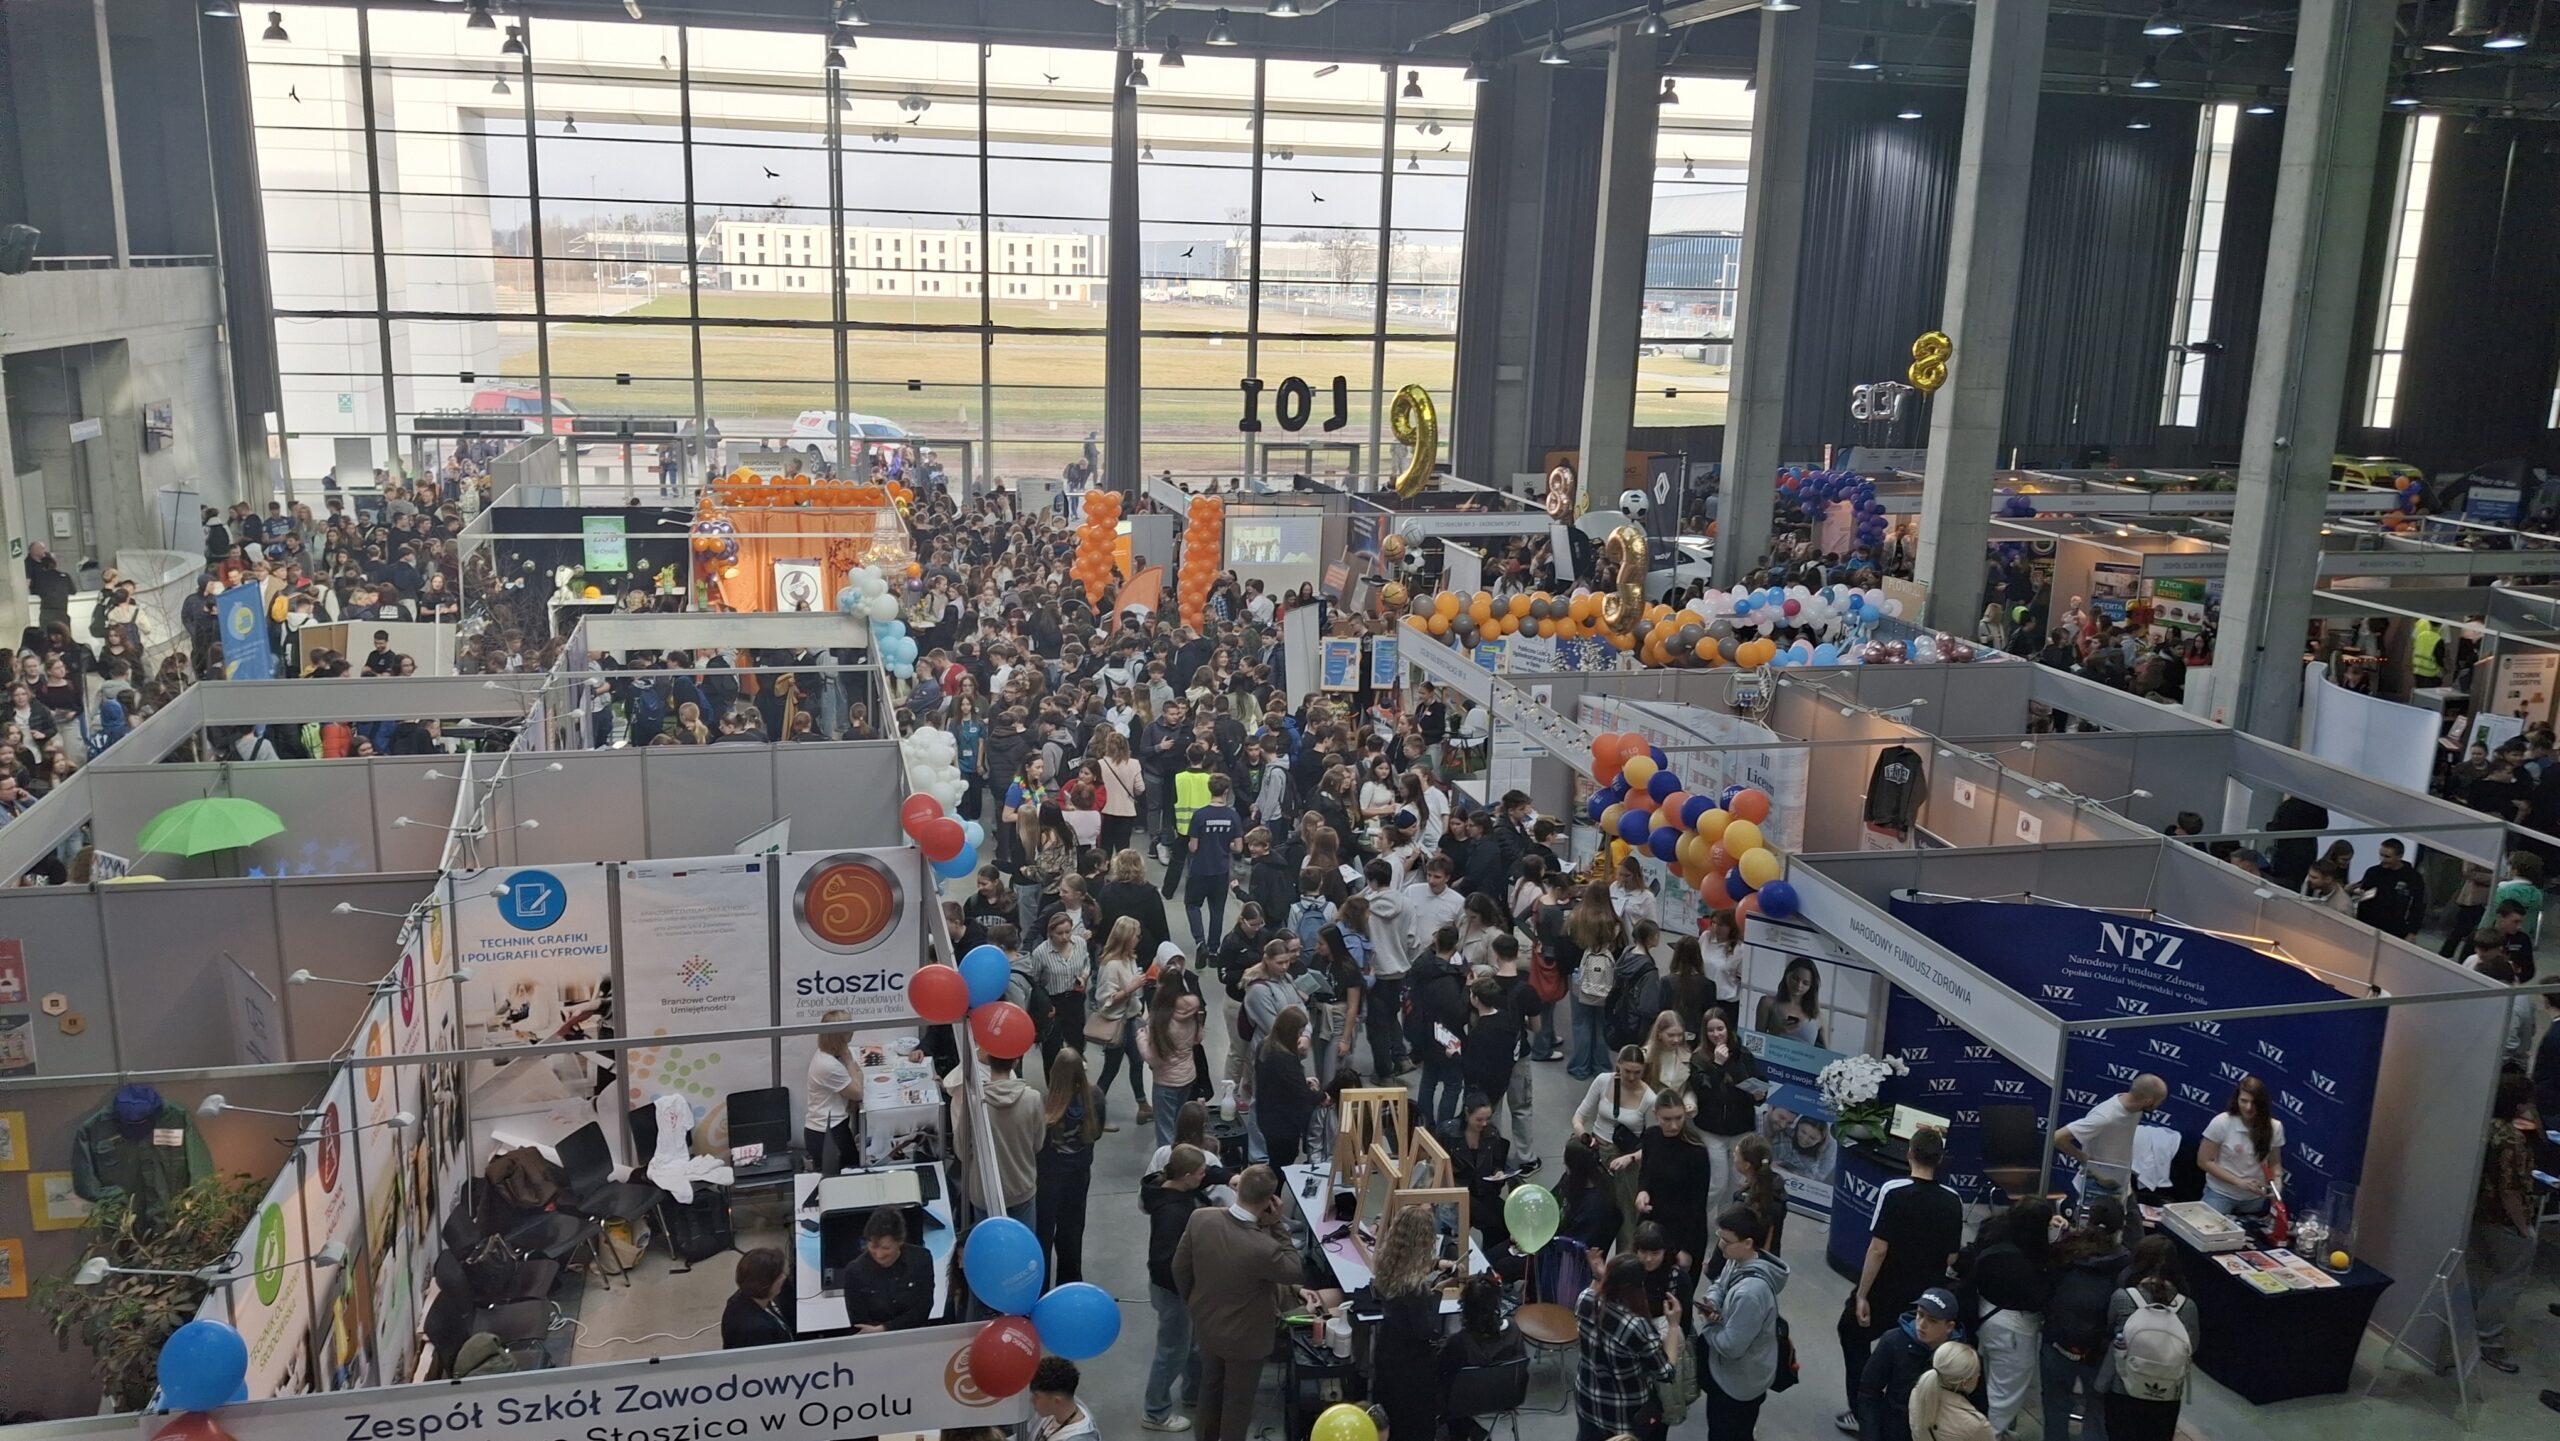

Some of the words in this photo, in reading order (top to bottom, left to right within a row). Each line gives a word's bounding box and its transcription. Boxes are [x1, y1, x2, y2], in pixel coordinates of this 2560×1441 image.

[1908, 331, 1953, 391] 8
[1747, 767, 1775, 797] Liceum
[480, 935, 535, 948] TECHNIK
[538, 933, 588, 945] GRAFIKI
[2096, 921, 2184, 970] NFZ
[468, 950, 538, 962] POLIGRAFII
[541, 945, 608, 958] CYFROWEJ
[1850, 917, 1893, 954] NARODOWY
[1894, 945, 1931, 979] FUNDUSZ
[1932, 969, 1972, 1005] ZDROWIA
[796, 969, 904, 995] staszic
[2061, 967, 2092, 978] Opolski
[2094, 971, 2125, 985] Oddział
[2127, 978, 2174, 996] Wojewódzki
[2068, 954, 2119, 972] Narodowy
[2122, 963, 2163, 980] Fundusz
[2165, 973, 2205, 992] Zdrowia
[661, 997, 704, 1006] Branżowe
[706, 995, 736, 1003] Centra
[796, 997, 824, 1008] Zespół
[826, 996, 848, 1006] Szkół
[850, 993, 904, 1005] Zawodowych
[2041, 984, 2074, 1000] NFZ
[671, 1004, 727, 1015] Umiejętności
[2116, 996, 2149, 1015] NFZ
[1901, 1047, 1928, 1060] NFZ
[1963, 1045, 1993, 1058] NFZ
[2149, 1038, 2181, 1059] NFZ
[2257, 1040, 2284, 1064] NFZ
[1767, 1066, 1784, 1079] Dbaj
[1791, 1074, 1813, 1086] swoje
[1928, 1078, 1956, 1091] NFZ
[1993, 1079, 2024, 1094] NFZ
[2310, 1069, 2336, 1095] NFZ
[2066, 1088, 2098, 1105] NFZ
[2180, 1083, 2210, 1105] NFZ
[2280, 1090, 2304, 1115] NFZ
[2300, 1142, 2325, 1168] NFZ
[1844, 1170, 1880, 1204] NFZ
[1922, 1292, 1946, 1310] adidas
[344, 1401, 483, 1441] Zespół
[497, 1389, 601, 1426] Szkół
[614, 1361, 854, 1413] Zawodowych
[760, 1412, 786, 1431] w
[800, 1394, 911, 1430] Opolu
